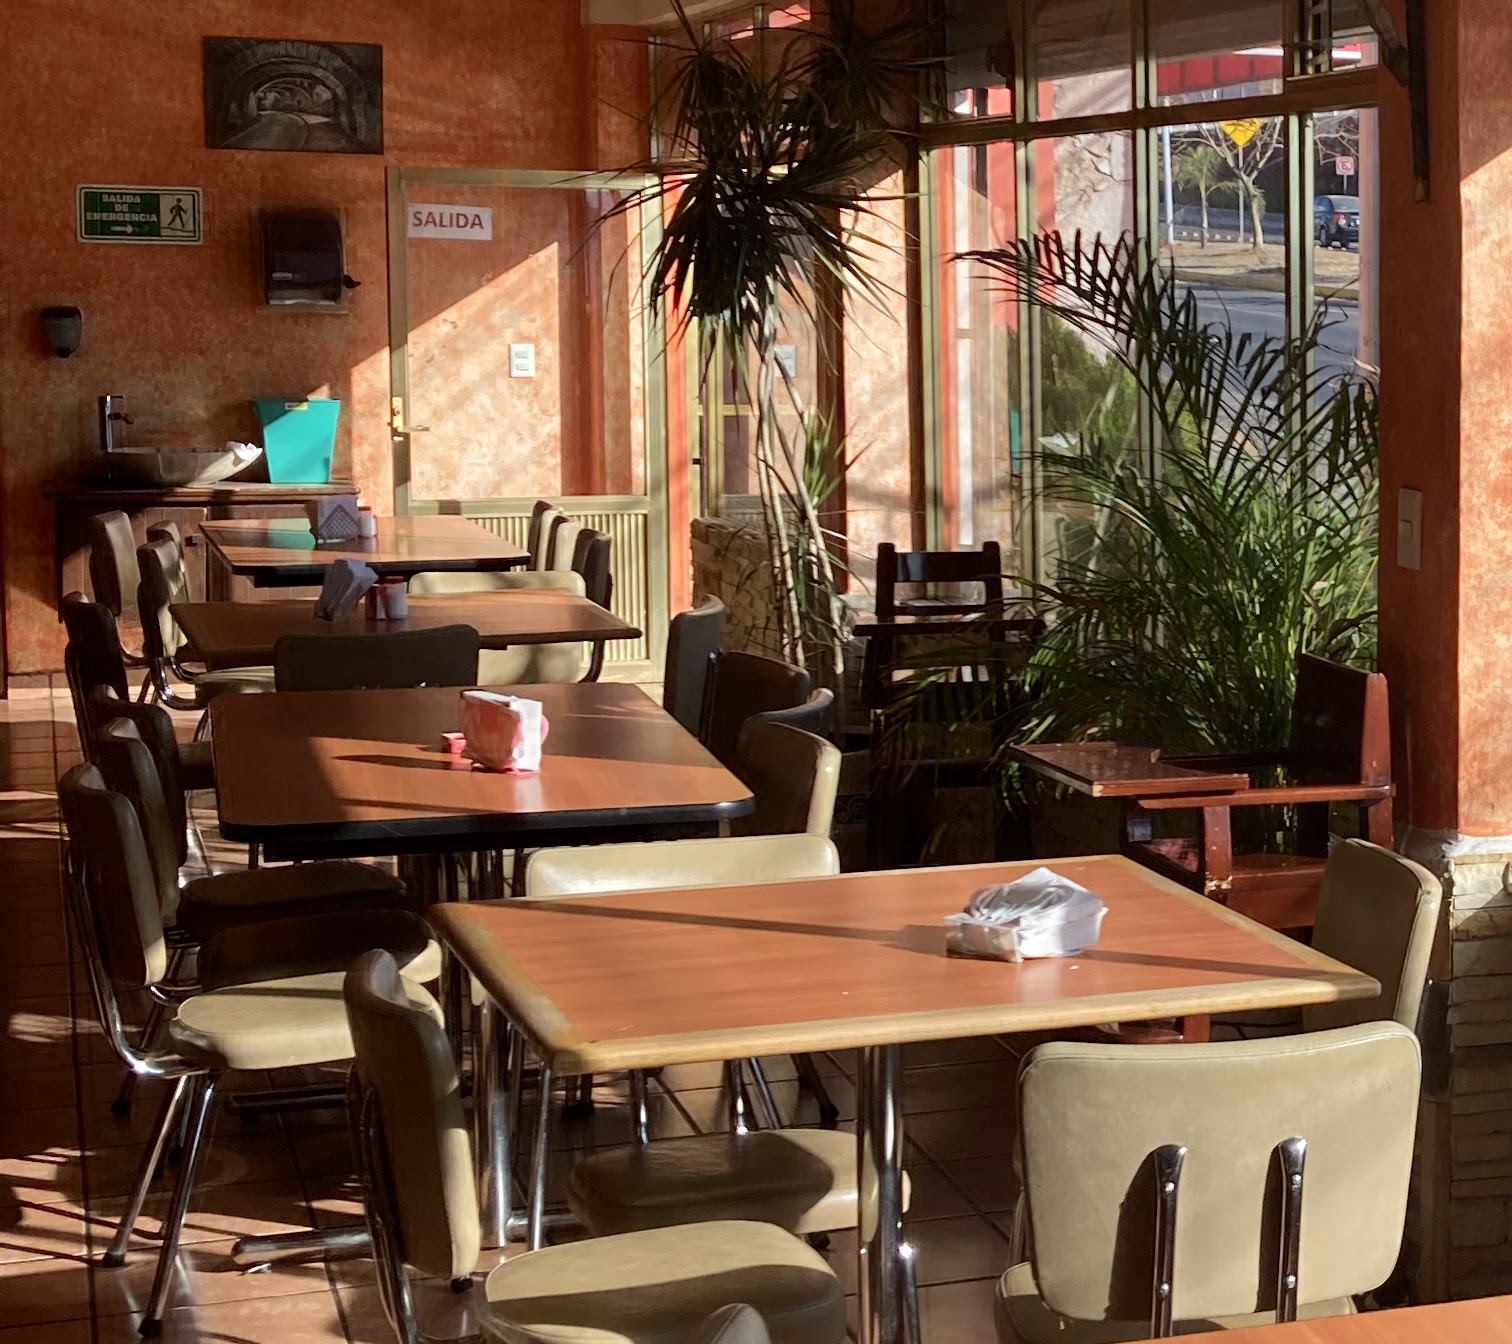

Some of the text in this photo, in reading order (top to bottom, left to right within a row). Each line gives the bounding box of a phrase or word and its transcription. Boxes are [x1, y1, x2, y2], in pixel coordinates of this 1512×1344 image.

[102, 194, 142, 203] SALIDA
[114, 204, 129, 212] DE
[86, 212, 158, 222] EMERGENCIA
[412, 211, 484, 230] SALIDA
